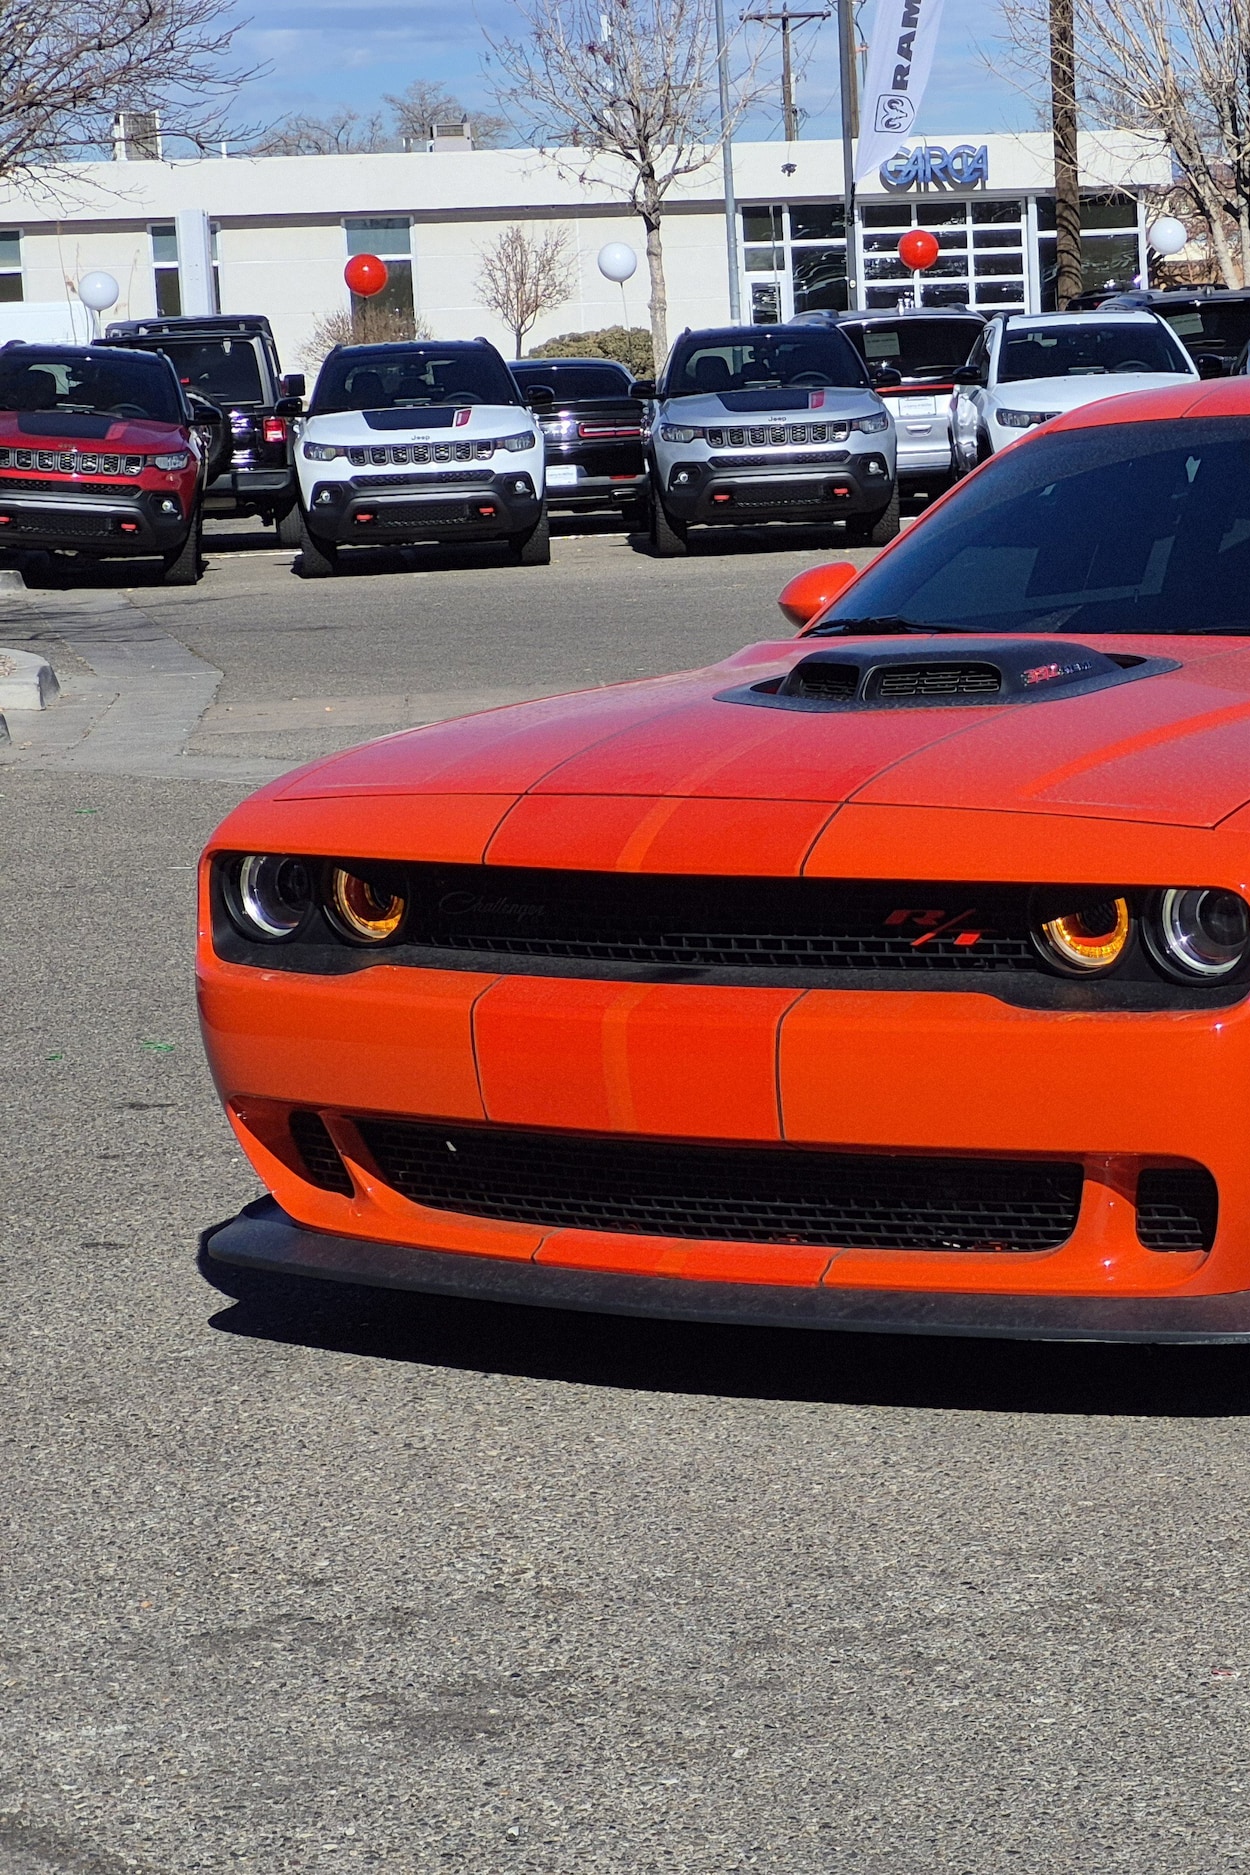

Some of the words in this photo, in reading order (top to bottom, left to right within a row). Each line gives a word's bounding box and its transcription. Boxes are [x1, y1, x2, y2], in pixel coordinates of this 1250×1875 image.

[892, 0, 921, 91] RAM
[879, 144, 989, 185] GARCIA
[439, 891, 546, 923] Challenger
[884, 908, 998, 947] R/T
